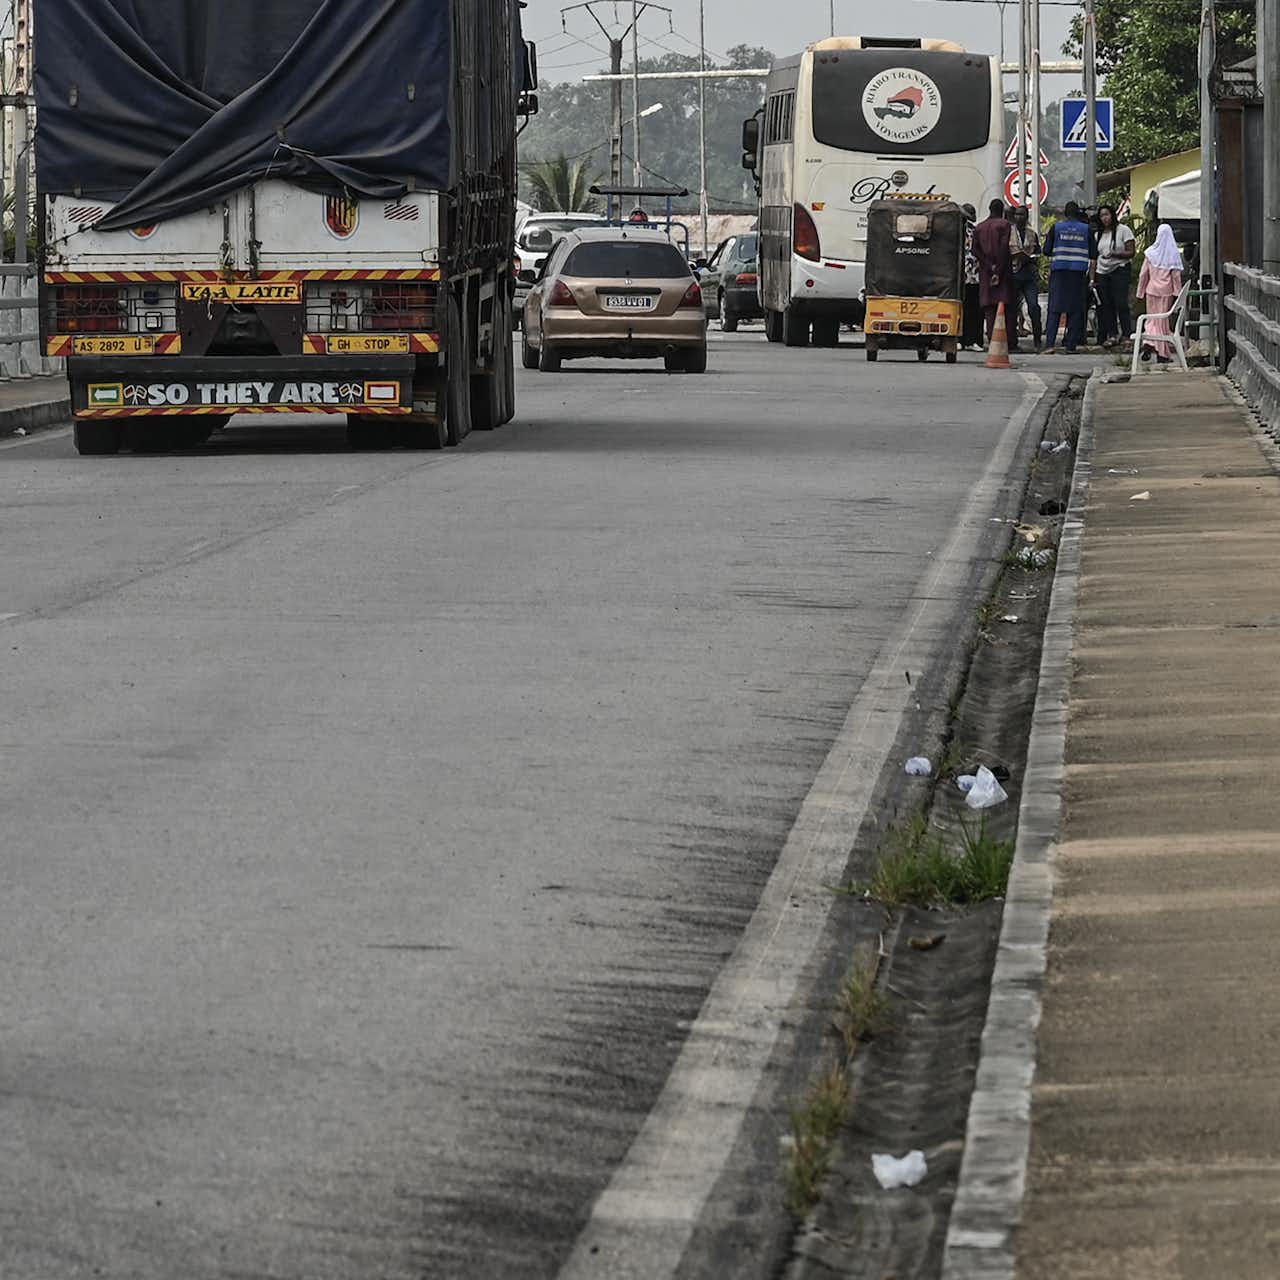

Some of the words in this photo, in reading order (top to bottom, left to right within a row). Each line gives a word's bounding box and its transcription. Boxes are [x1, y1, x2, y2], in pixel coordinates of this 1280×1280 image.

[865, 74, 890, 104] RIMBO
[892, 71, 938, 108] TRANSPORT
[875, 121, 928, 139] VOYAGEURS
[895, 247, 931, 255] APSONIC
[236, 286, 296, 298] LATIF
[900, 301, 920, 315] B2
[79, 339, 93, 352] AS
[99, 340, 125, 352] 2892
[147, 383, 189, 405] SO
[196, 382, 274, 404] THEY
[280, 382, 340, 404] ARE
